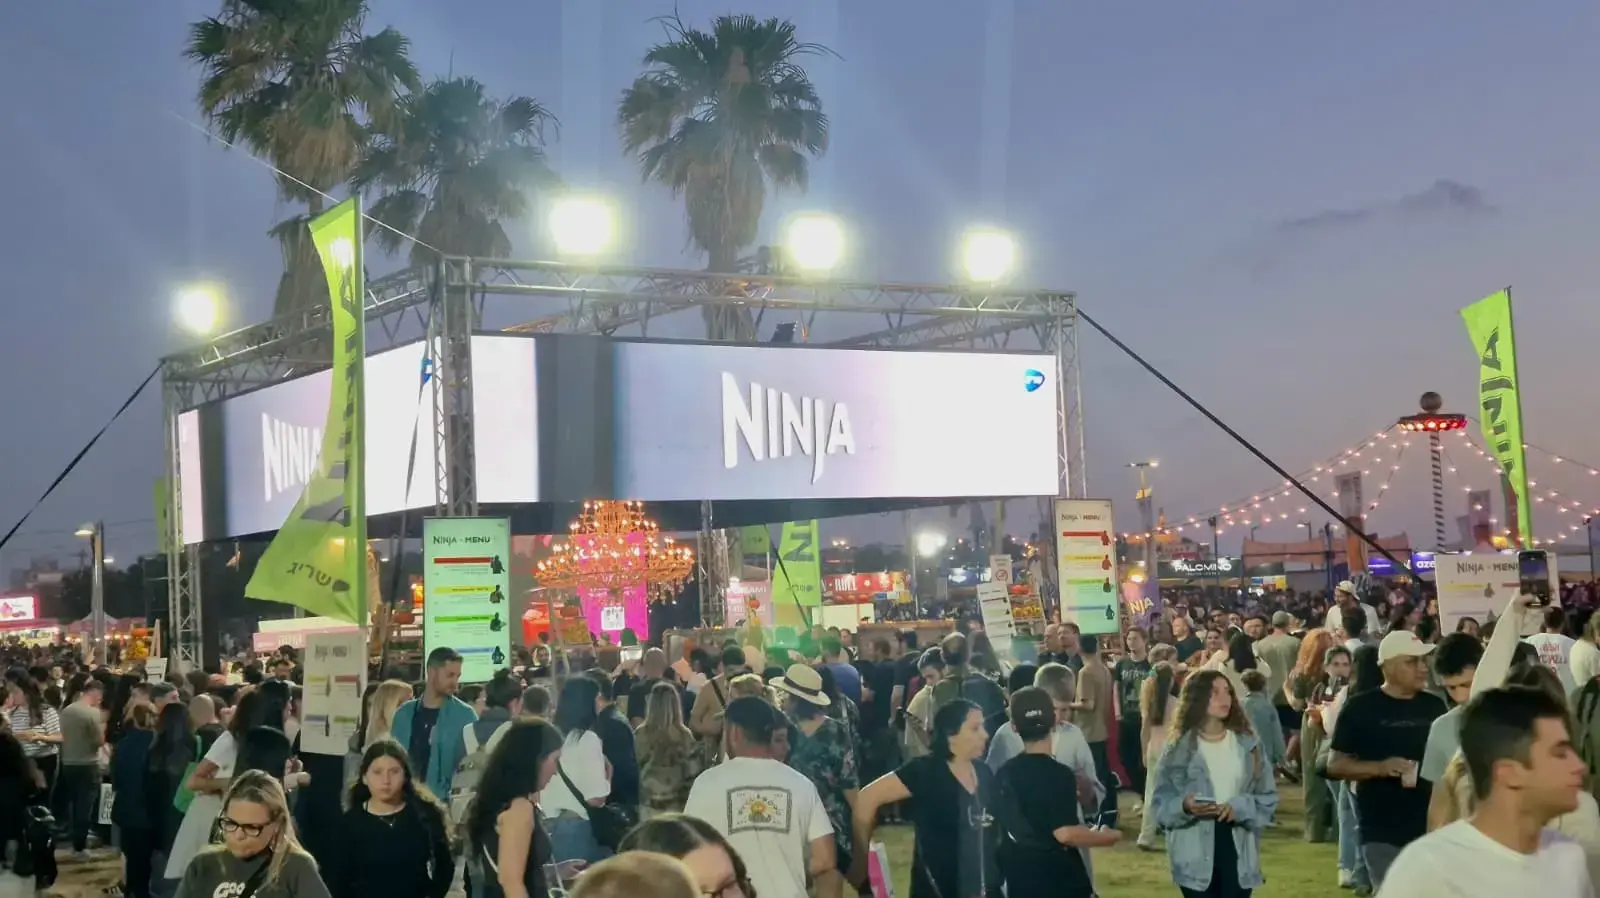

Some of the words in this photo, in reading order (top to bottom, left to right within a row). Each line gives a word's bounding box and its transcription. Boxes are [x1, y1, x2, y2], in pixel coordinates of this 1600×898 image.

[720, 371, 856, 486] NINJA
[433, 535, 457, 549] NINJA
[465, 535, 491, 544] MENU
[1175, 563, 1232, 573] PALOMINO
[1456, 561, 1484, 575] NINJA
